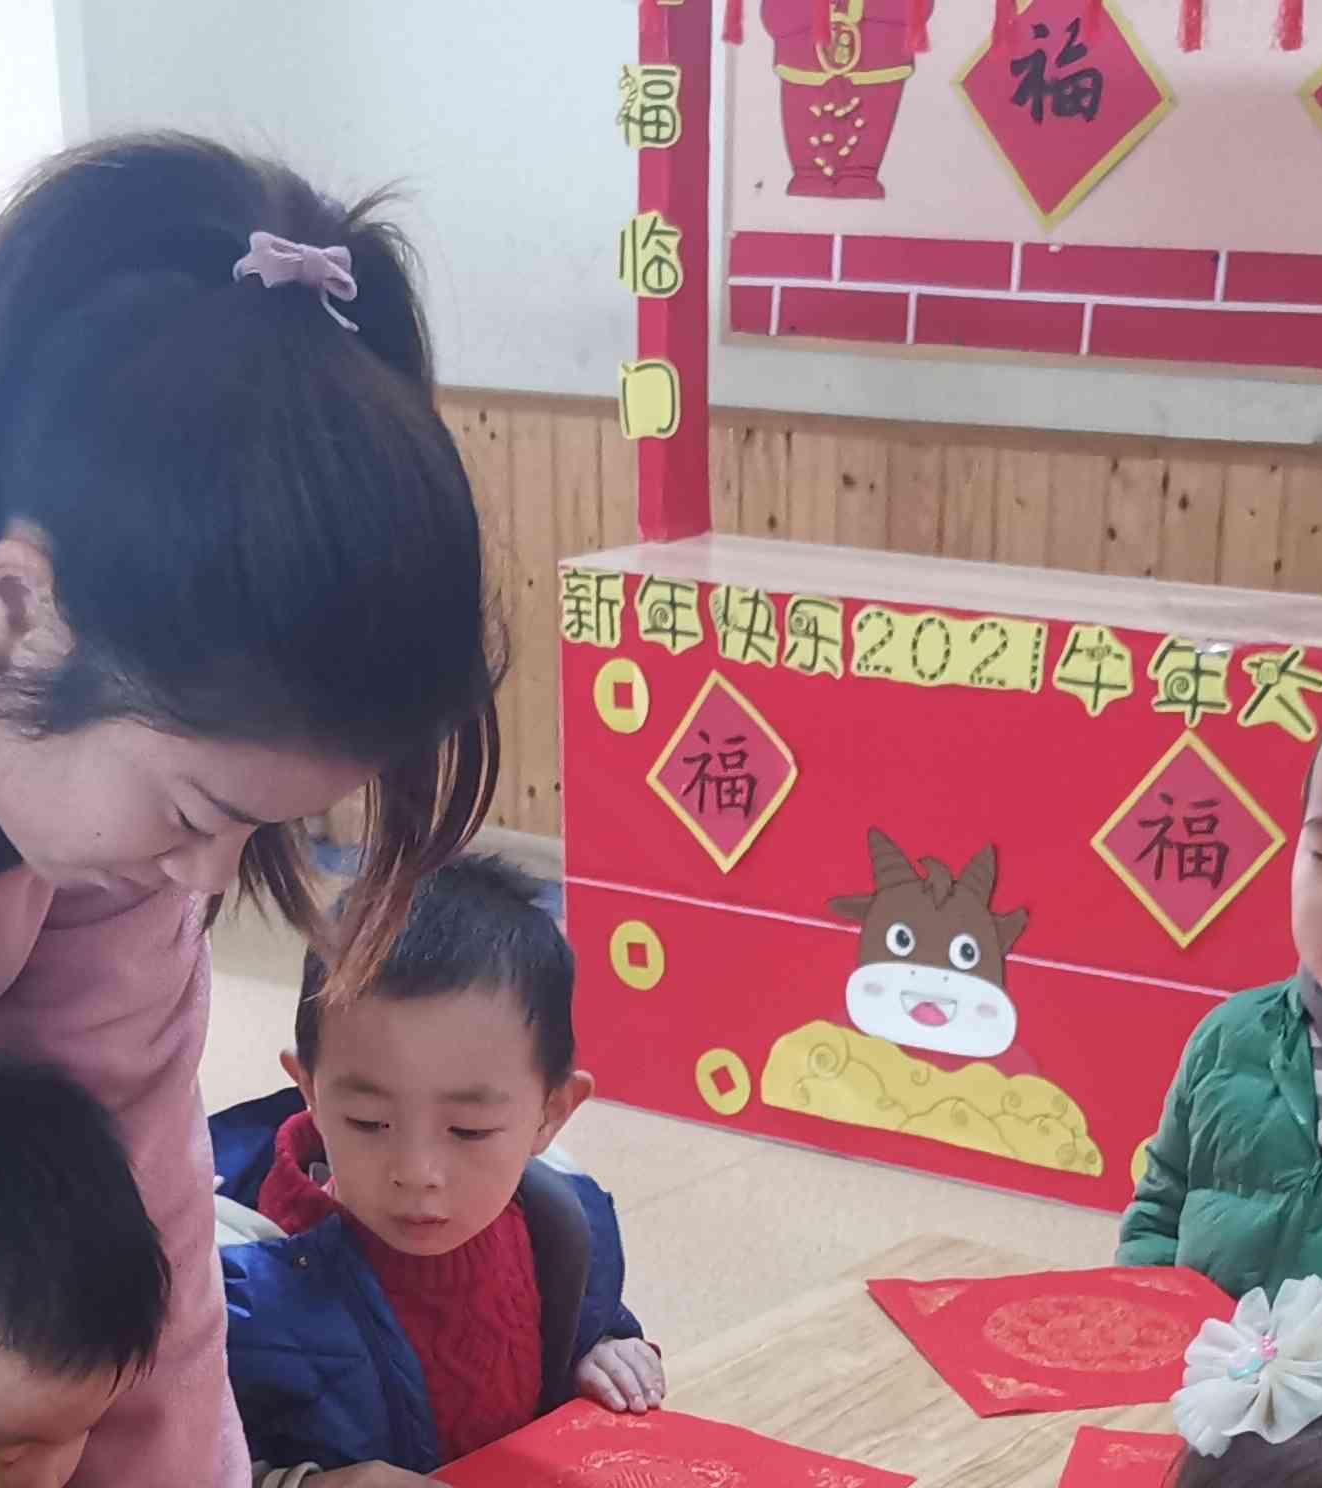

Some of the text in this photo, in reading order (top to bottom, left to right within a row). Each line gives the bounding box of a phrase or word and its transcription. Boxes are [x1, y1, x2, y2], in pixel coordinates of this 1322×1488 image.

[1010, 17, 1104, 124] 福
[682, 730, 758, 818] 福
[1135, 792, 1230, 888] 福
